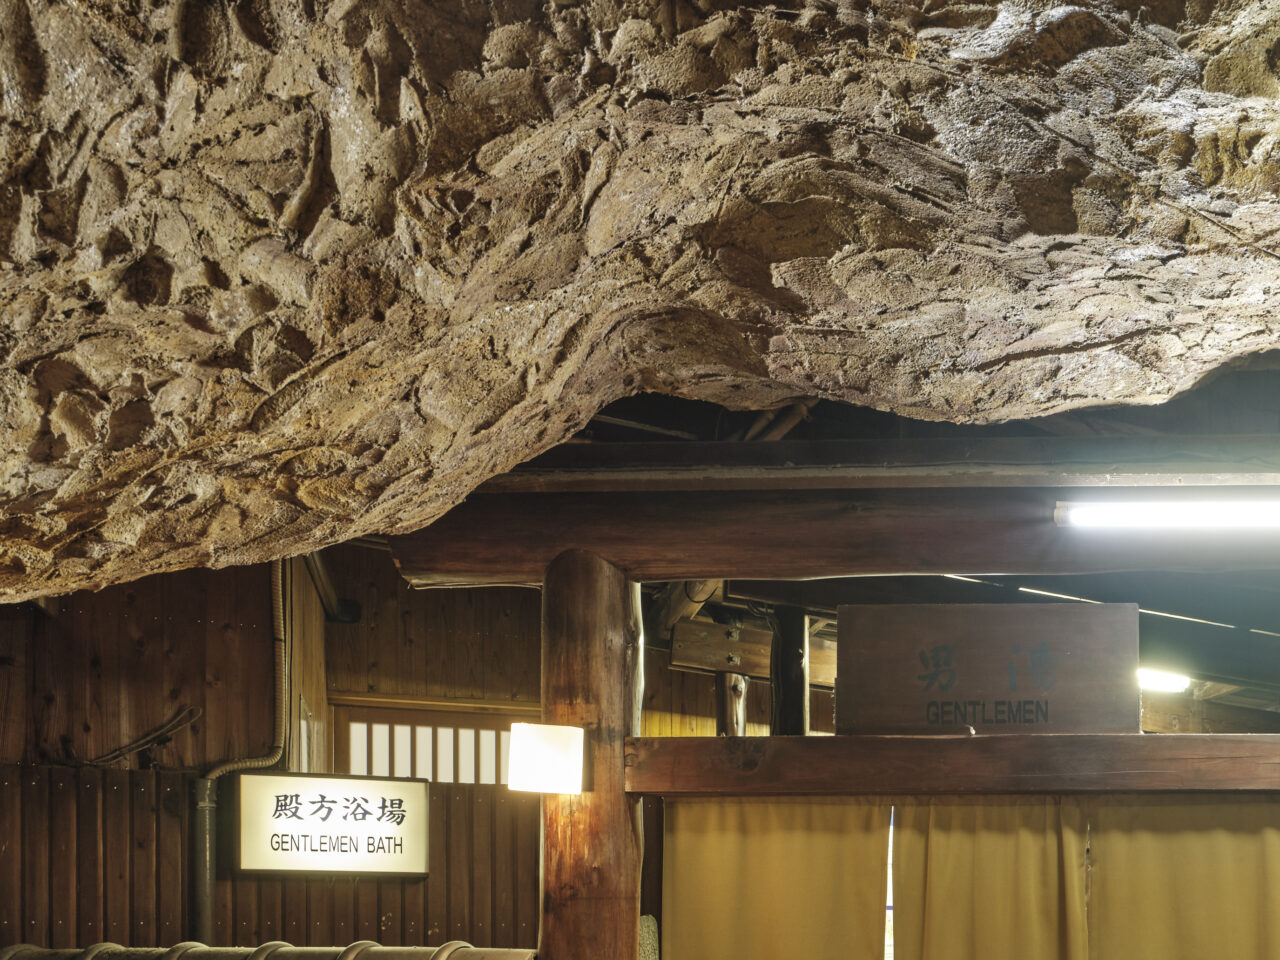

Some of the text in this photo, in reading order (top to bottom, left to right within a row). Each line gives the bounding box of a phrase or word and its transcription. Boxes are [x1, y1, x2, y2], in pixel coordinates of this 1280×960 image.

[926, 699, 1049, 725] GENTLEMEN
[272, 794, 407, 826] 殿方浴場
[270, 833, 403, 854] GENTLEMEN BATH
